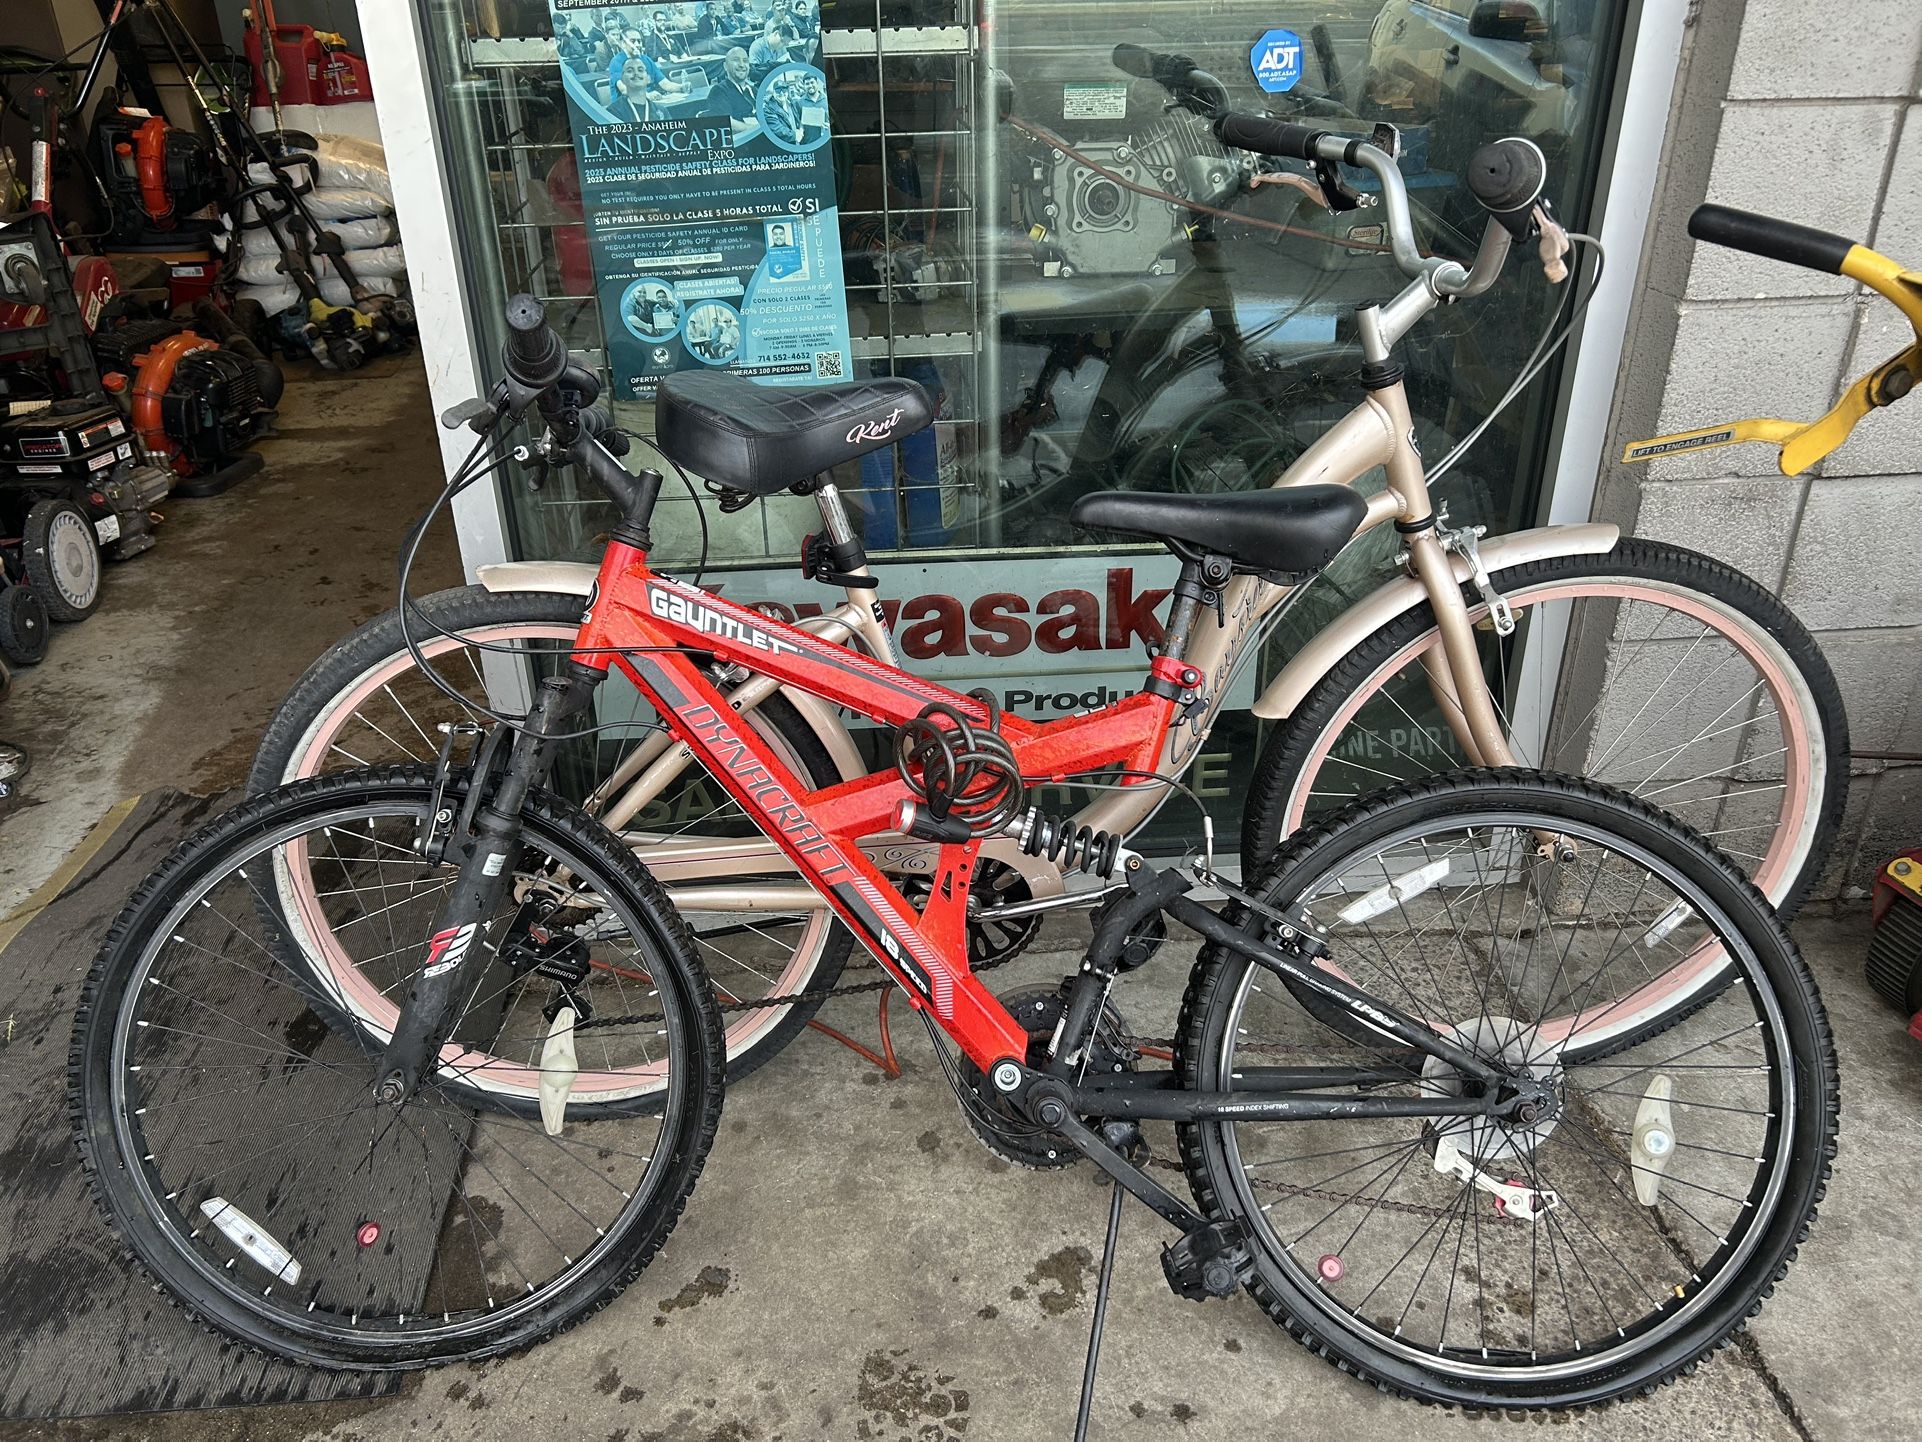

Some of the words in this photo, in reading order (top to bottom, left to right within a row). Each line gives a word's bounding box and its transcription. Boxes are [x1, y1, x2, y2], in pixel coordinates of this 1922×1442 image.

[1258, 46, 1300, 70] ADT
[587, 125, 608, 135] THE
[611, 123, 632, 133] 2023
[641, 120, 687, 132] ANAHEIM
[580, 128, 733, 158] LANDSCAPE
[606, 166, 640, 176] ANNUAL
[642, 163, 680, 173] PESTICIDE
[682, 160, 710, 170] SAFETY
[712, 158, 738, 168] CLASS
[738, 157, 755, 165] FOR
[756, 153, 815, 164] LANDSCAPERS!
[708, 150, 734, 160] EXPO
[605, 172, 626, 182] CLASE
[627, 172, 637, 180] DE
[638, 170, 677, 180] SEGURIDAD
[678, 168, 702, 177] ANUAL
[702, 166, 712, 174] DE
[712, 164, 751, 174] PESTICIDAS
[752, 163, 770, 171] PARA
[771, 161, 816, 170] JARDINEROS!
[595, 217, 610, 226] SIN
[612, 215, 646, 224] PRUEBA
[647, 213, 671, 222] SOLO
[686, 210, 713, 218] CLASE
[723, 206, 754, 215] HORAS
[755, 204, 782, 212] TOTAL
[760, 304, 812, 314] DESCUENTO
[773, 352, 810, 361] 552-4632
[772, 364, 809, 373] PERSONAS
[630, 376, 658, 384] OFERTA
[846, 408, 904, 444] Kent
[1633, 448, 1650, 456] LIFT
[1665, 438, 1704, 450] ENGAGE
[1704, 434, 1729, 444] REEL
[1004, 685, 1136, 712] Produ
[1390, 725, 1460, 758] PART
[681, 704, 857, 879] DYNACRAFT
[880, 928, 901, 960] 18
[538, 964, 578, 980] SHIMANO
